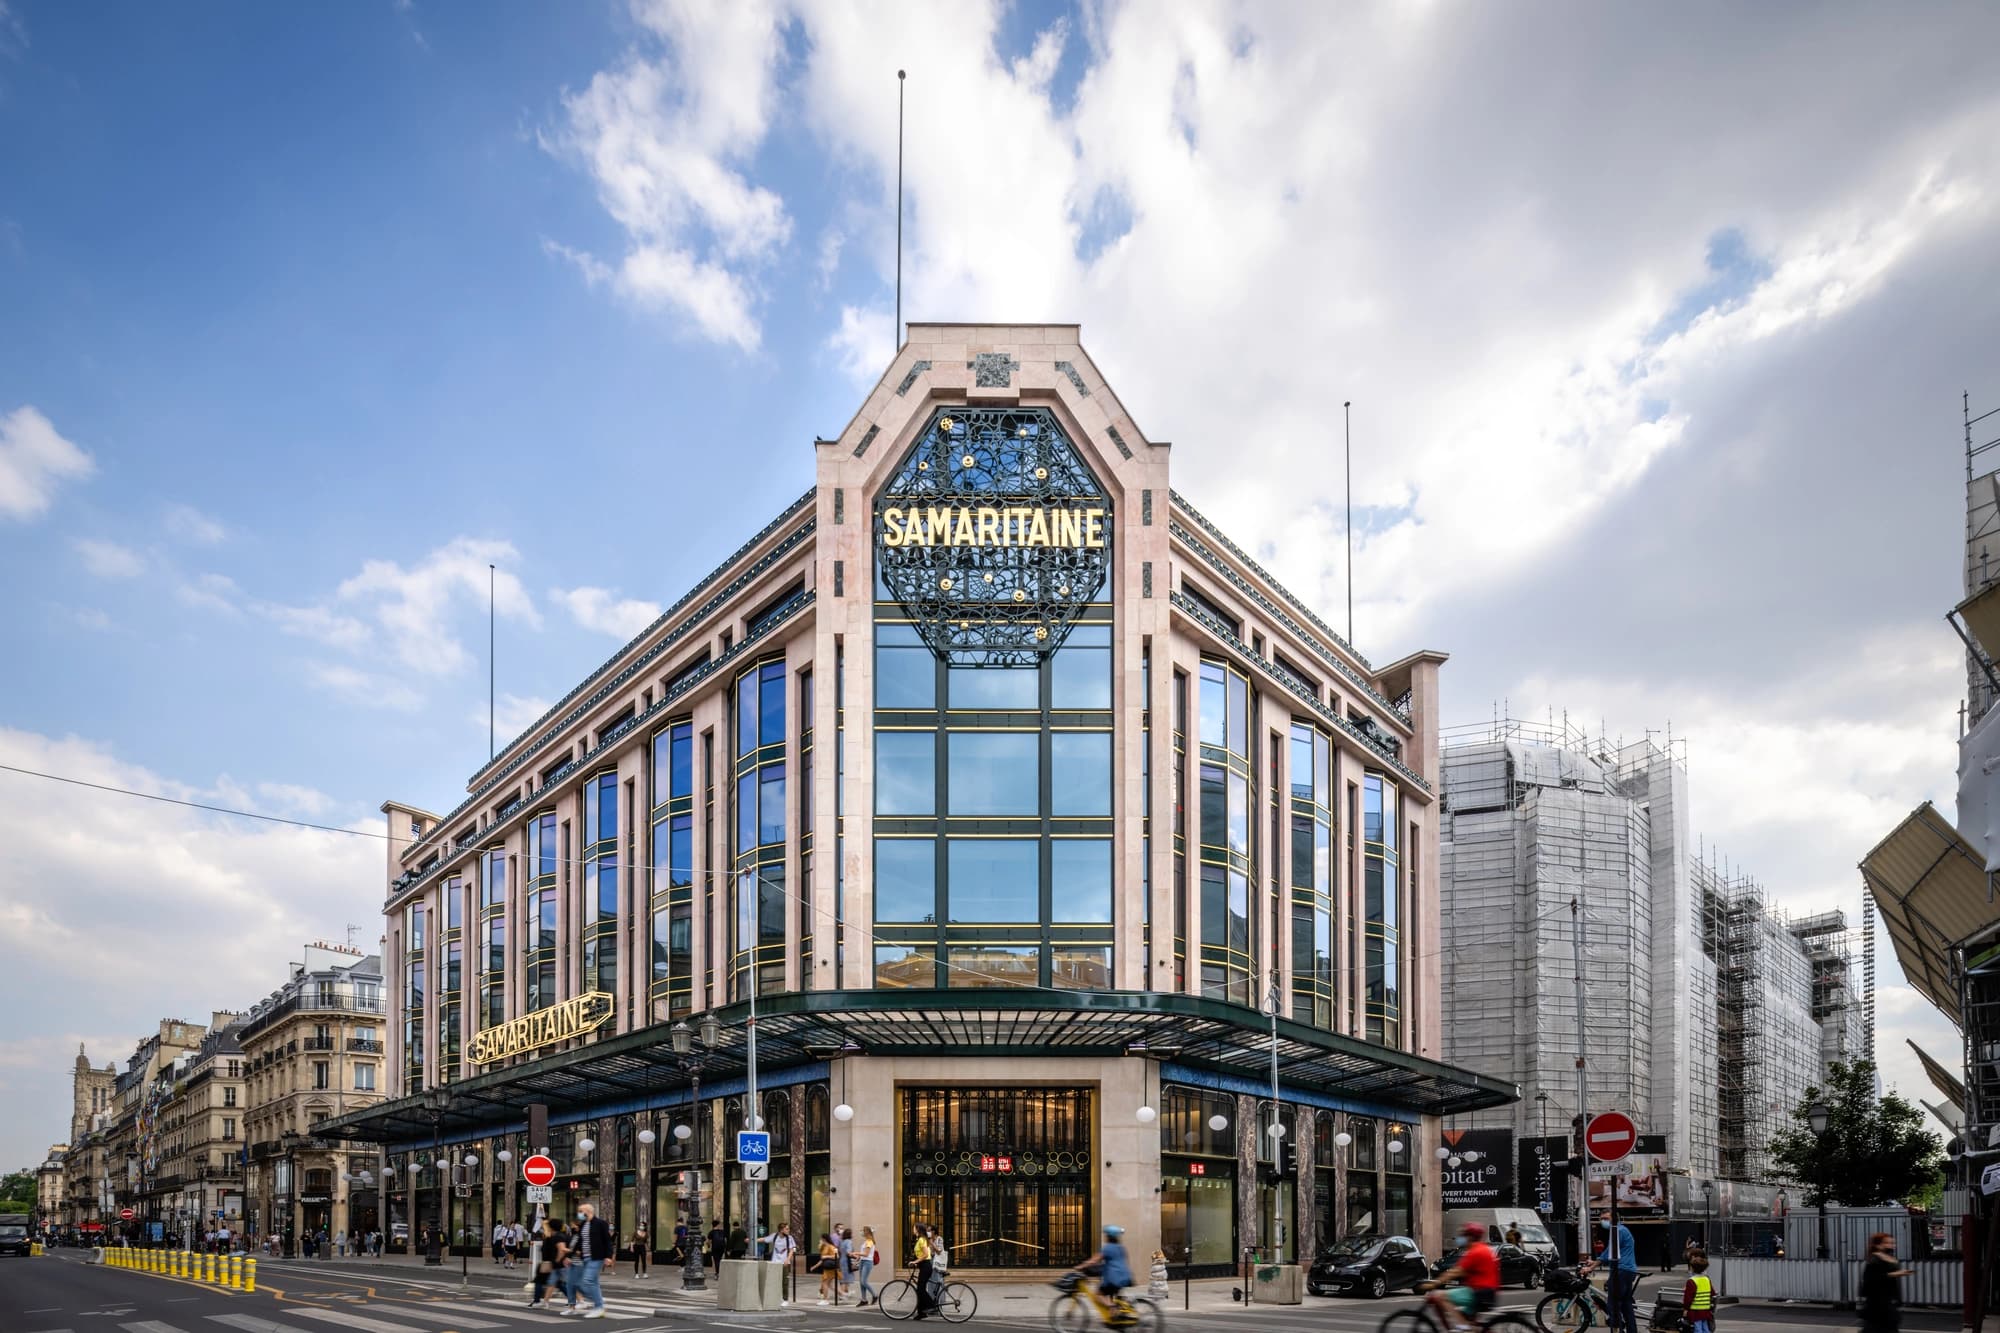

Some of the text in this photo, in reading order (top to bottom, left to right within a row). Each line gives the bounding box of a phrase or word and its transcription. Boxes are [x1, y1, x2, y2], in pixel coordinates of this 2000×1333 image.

[883, 506, 1105, 548] SAMARITAINE
[475, 997, 593, 1060] SAMARITAINE
[1591, 1166, 1613, 1174] SAUF
[1464, 1189, 1499, 1197] PENDANT
